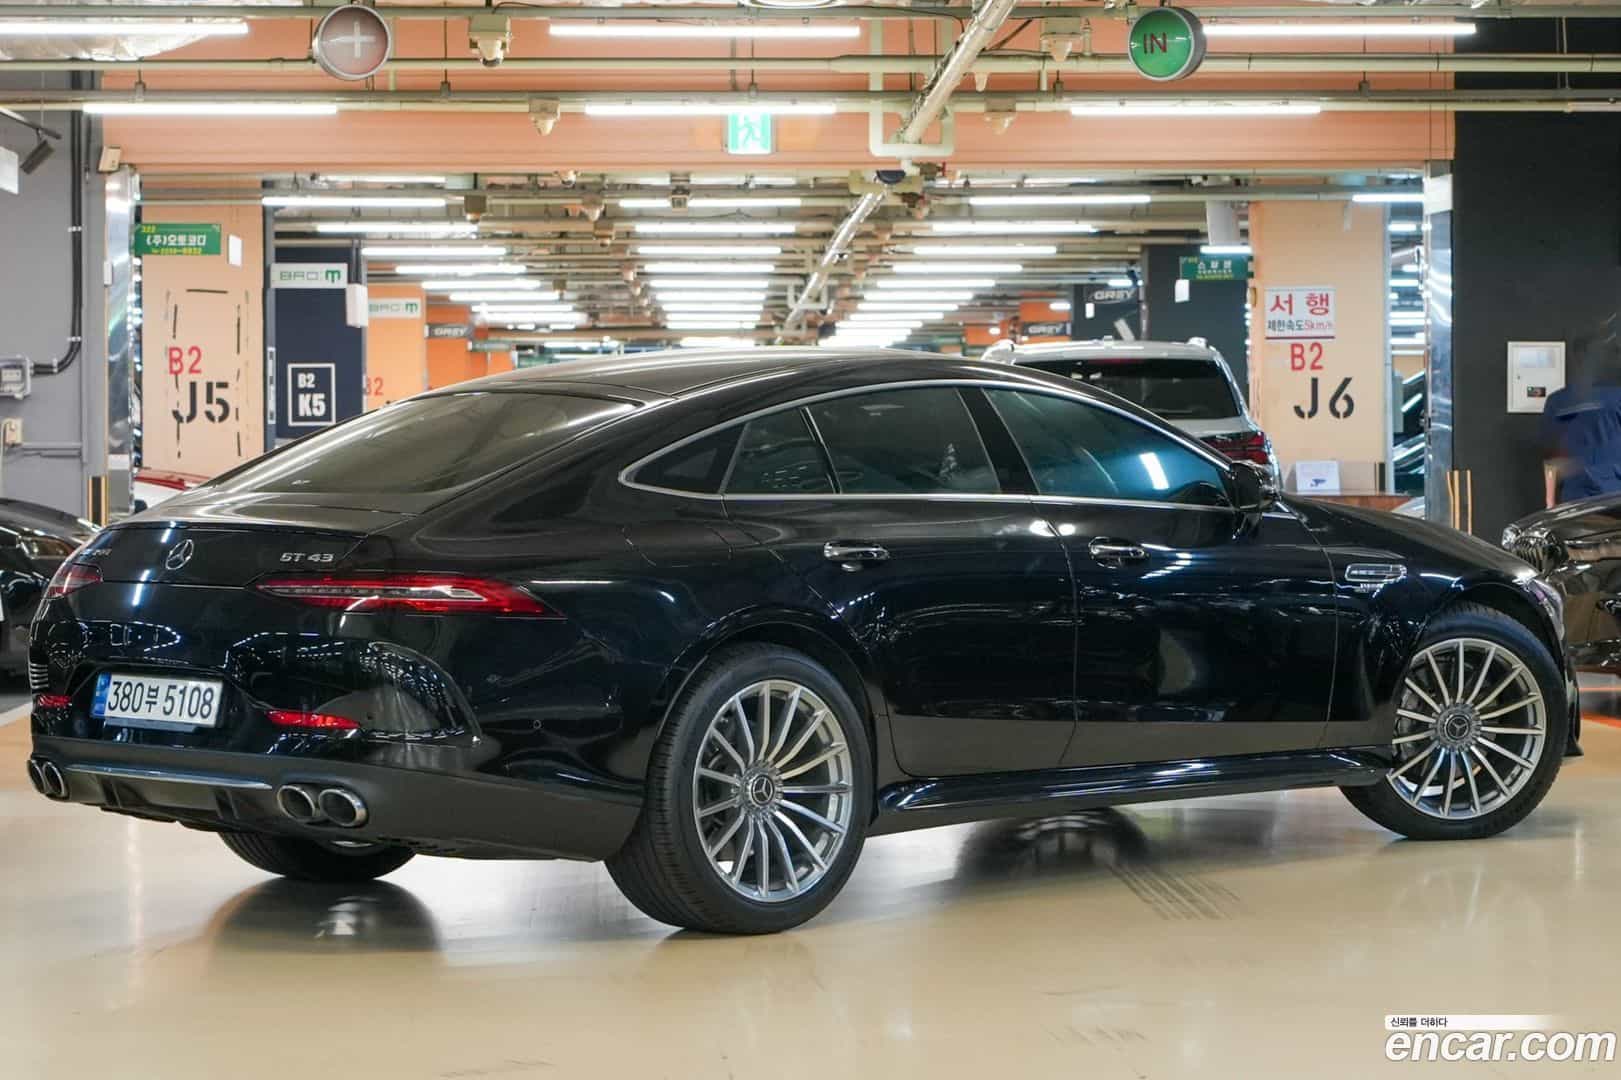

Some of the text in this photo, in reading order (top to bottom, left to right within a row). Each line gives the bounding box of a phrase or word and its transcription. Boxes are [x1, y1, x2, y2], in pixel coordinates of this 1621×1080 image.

[1143, 32, 1167, 54] IN
[168, 346, 202, 375] B2
[1290, 342, 1324, 371] B2
[297, 373, 316, 388] B2
[172, 381, 231, 424] J5
[299, 393, 326, 417] K5
[1293, 377, 1355, 419] J6
[307, 553, 334, 562] 43
